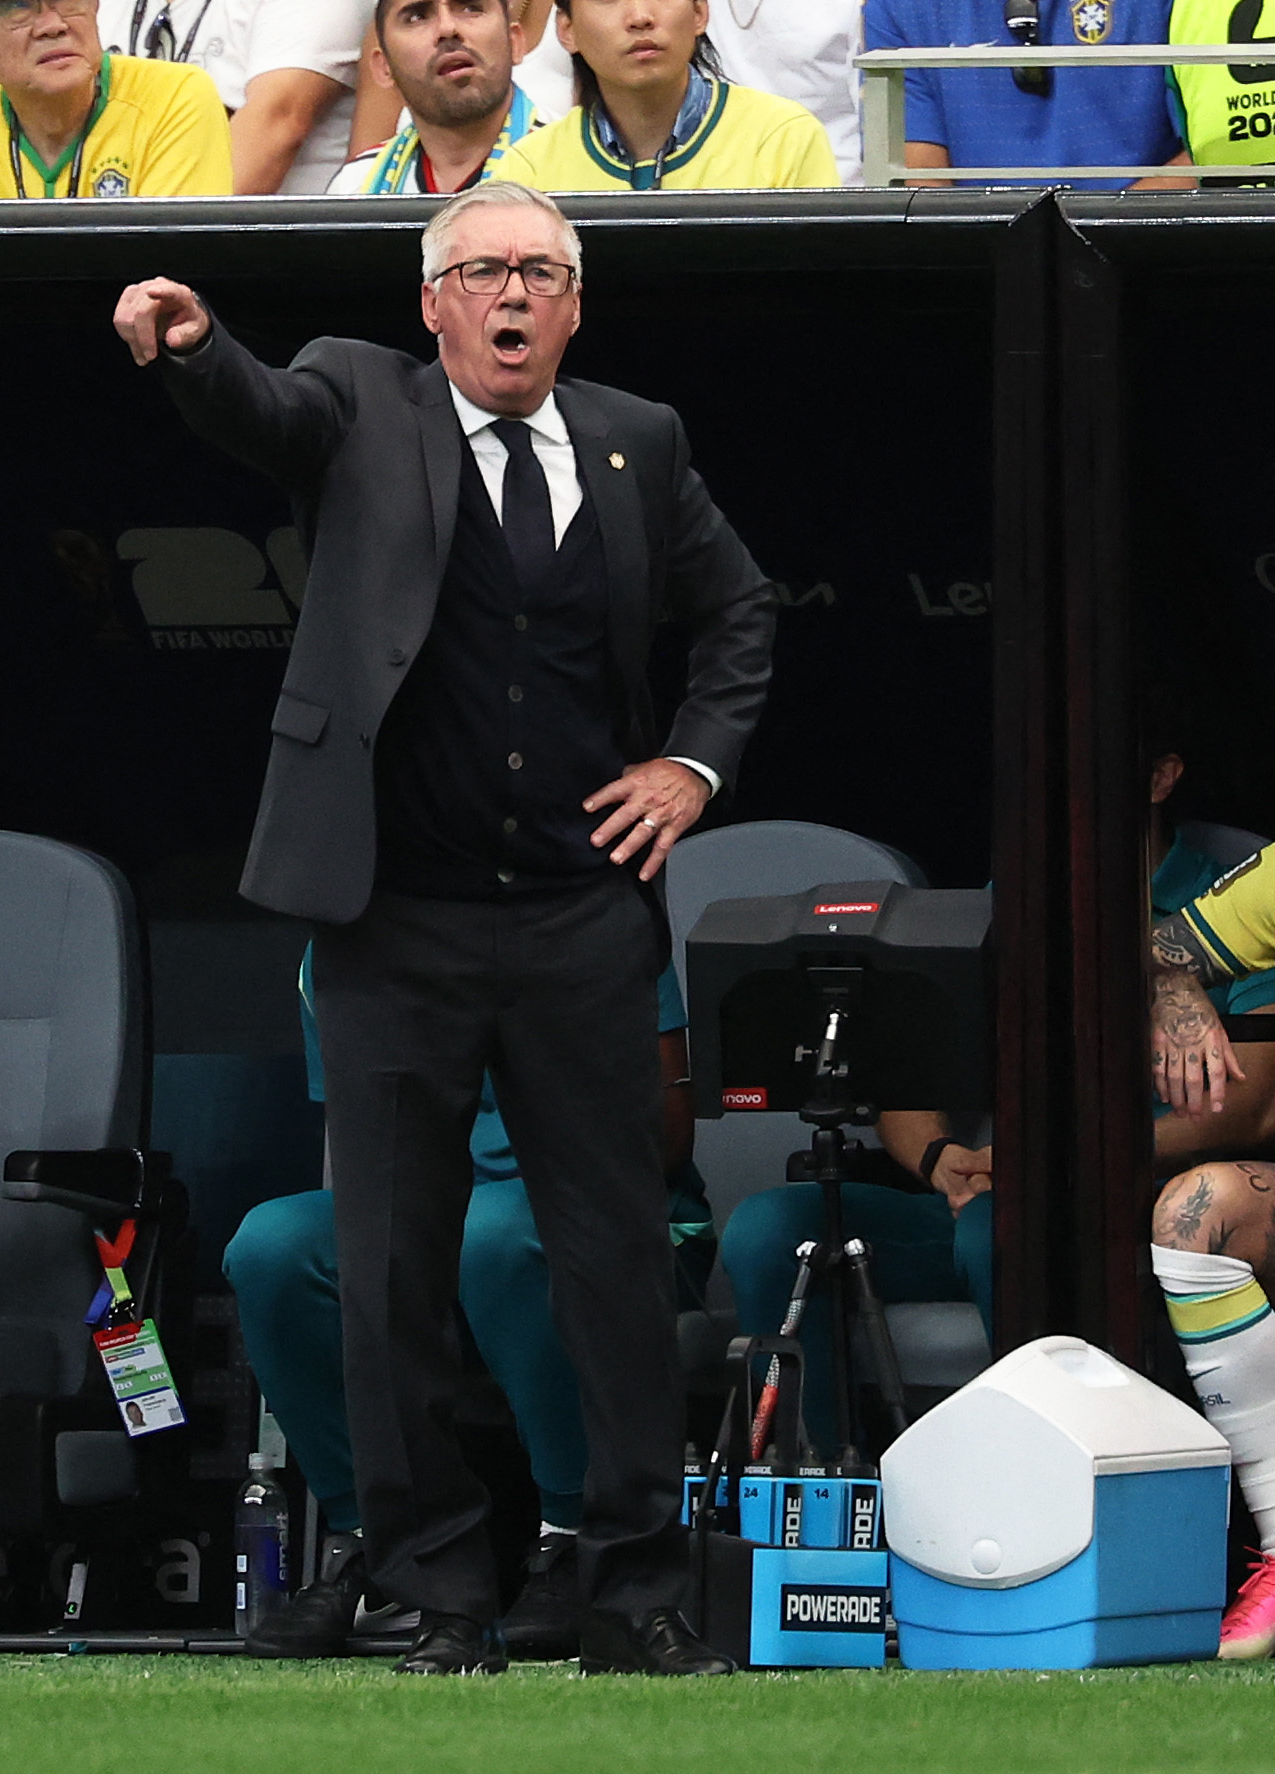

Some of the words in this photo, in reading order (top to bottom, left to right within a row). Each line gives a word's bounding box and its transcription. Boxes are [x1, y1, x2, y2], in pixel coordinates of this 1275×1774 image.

[1228, 112, 1275, 141] 20
[150, 630, 209, 649] FIFA
[819, 905, 872, 913] Lenovo
[744, 1487, 759, 1499] 24
[814, 1488, 830, 1499] 14
[786, 1593, 881, 1624] POWERADE
